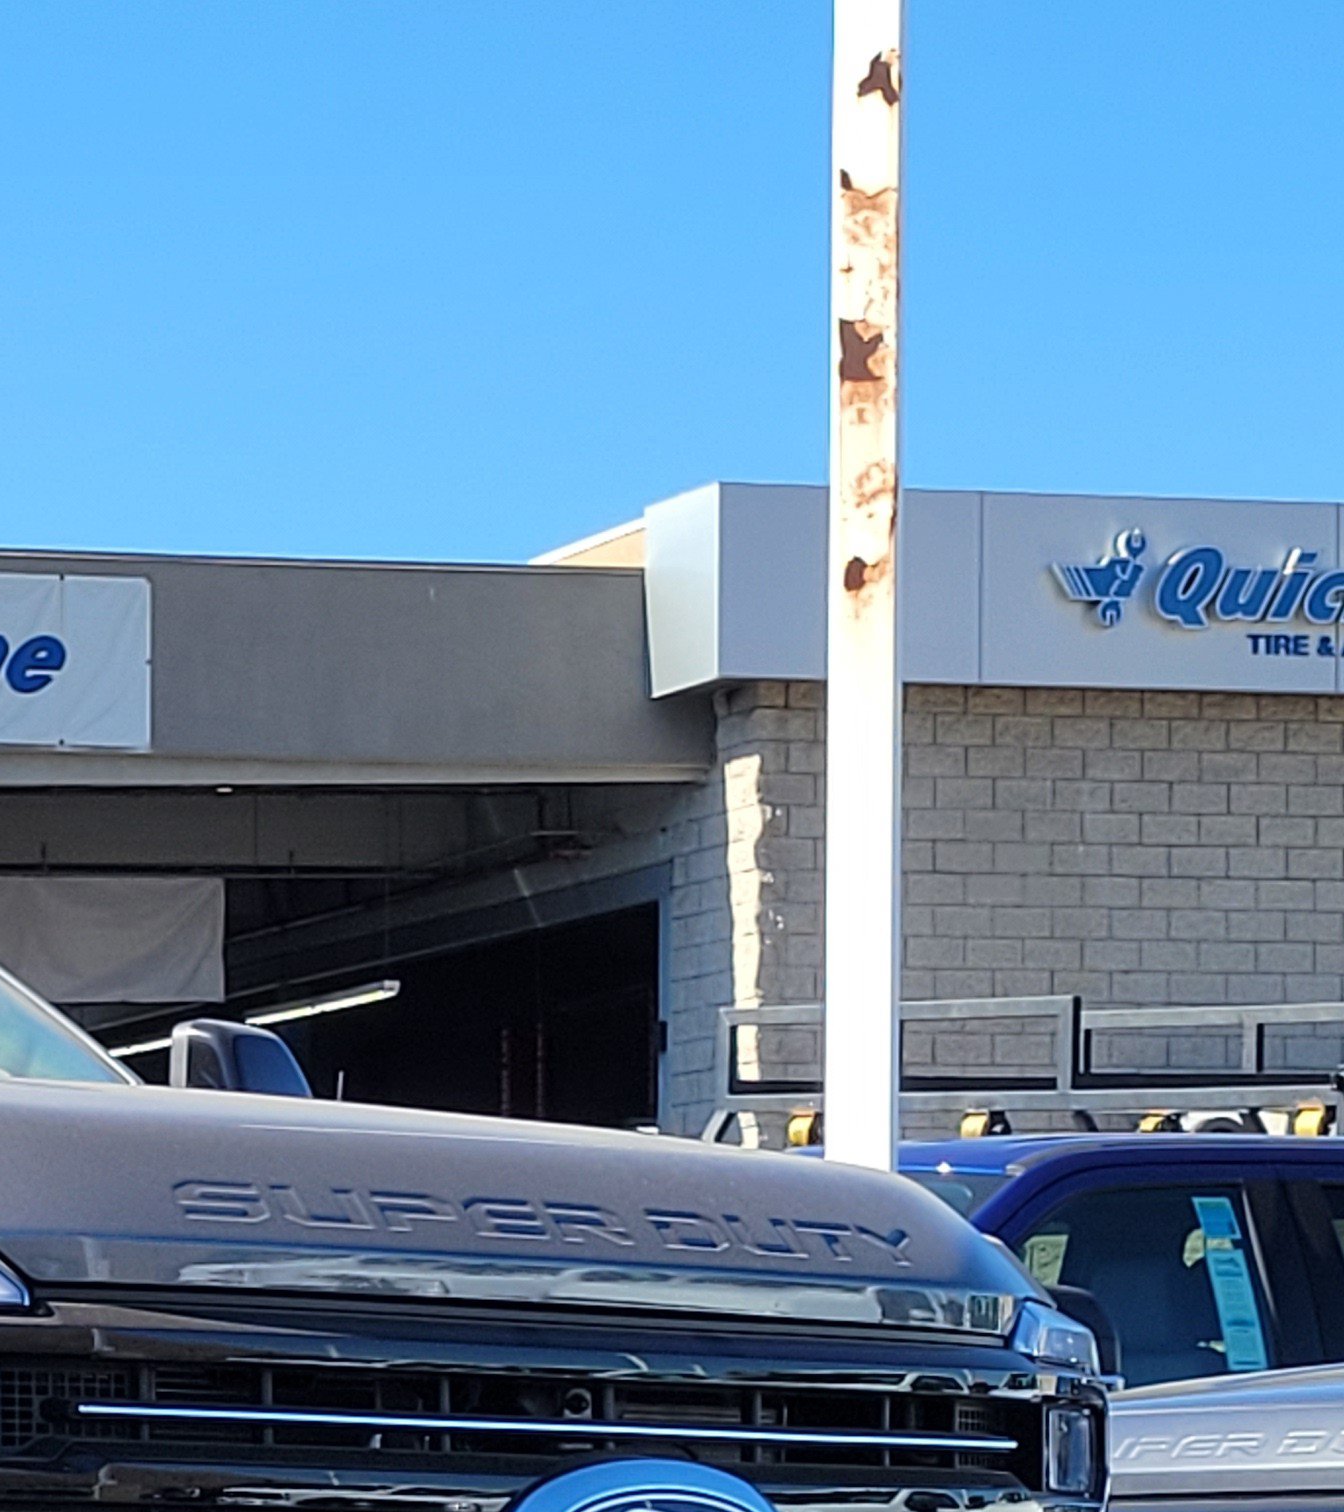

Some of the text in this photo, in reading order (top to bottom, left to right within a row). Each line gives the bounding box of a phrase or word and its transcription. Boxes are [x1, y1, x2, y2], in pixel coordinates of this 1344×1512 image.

[1247, 634, 1336, 657] TIRE &
[173, 1180, 914, 1268] SUPER DUTY
